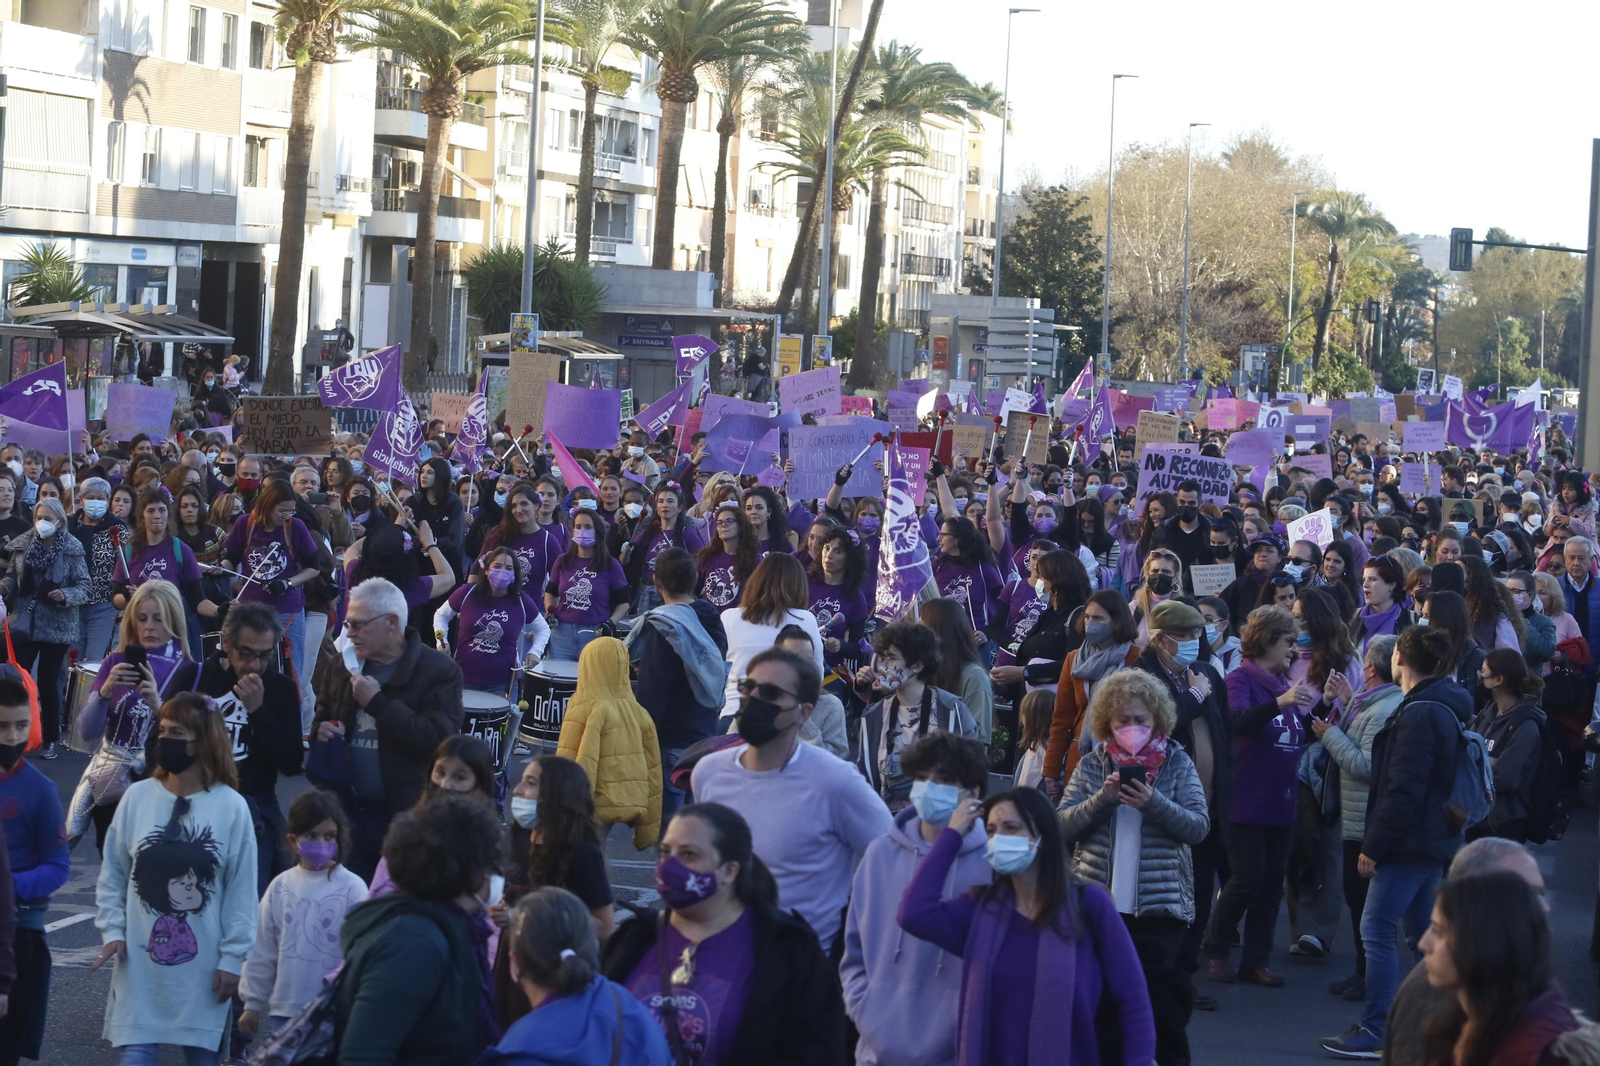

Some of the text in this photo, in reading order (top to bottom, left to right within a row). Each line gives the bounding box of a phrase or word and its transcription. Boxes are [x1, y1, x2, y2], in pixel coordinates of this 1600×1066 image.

[626, 317, 635, 326] P
[632, 338, 665, 346] ENTRADA
[514, 354, 552, 368] VAMOS
[517, 367, 549, 382] TODAS
[511, 383, 546, 397] A VOLA
[803, 393, 815, 403] ARE
[816, 386, 836, 398] TRYING
[250, 399, 285, 412] DONDE
[552, 391, 580, 410] OTRO
[250, 414, 261, 425] EL
[553, 411, 609, 426] HASTA EL
[247, 426, 321, 440] HOY GRITA LA
[553, 425, 612, 443] CHOCHO
[792, 432, 805, 448] LO
[808, 432, 855, 448] CONTRARIO
[967, 431, 985, 442] piropo
[254, 440, 298, 454] RABIA
[1144, 453, 1231, 480] NO RECONOZCO
